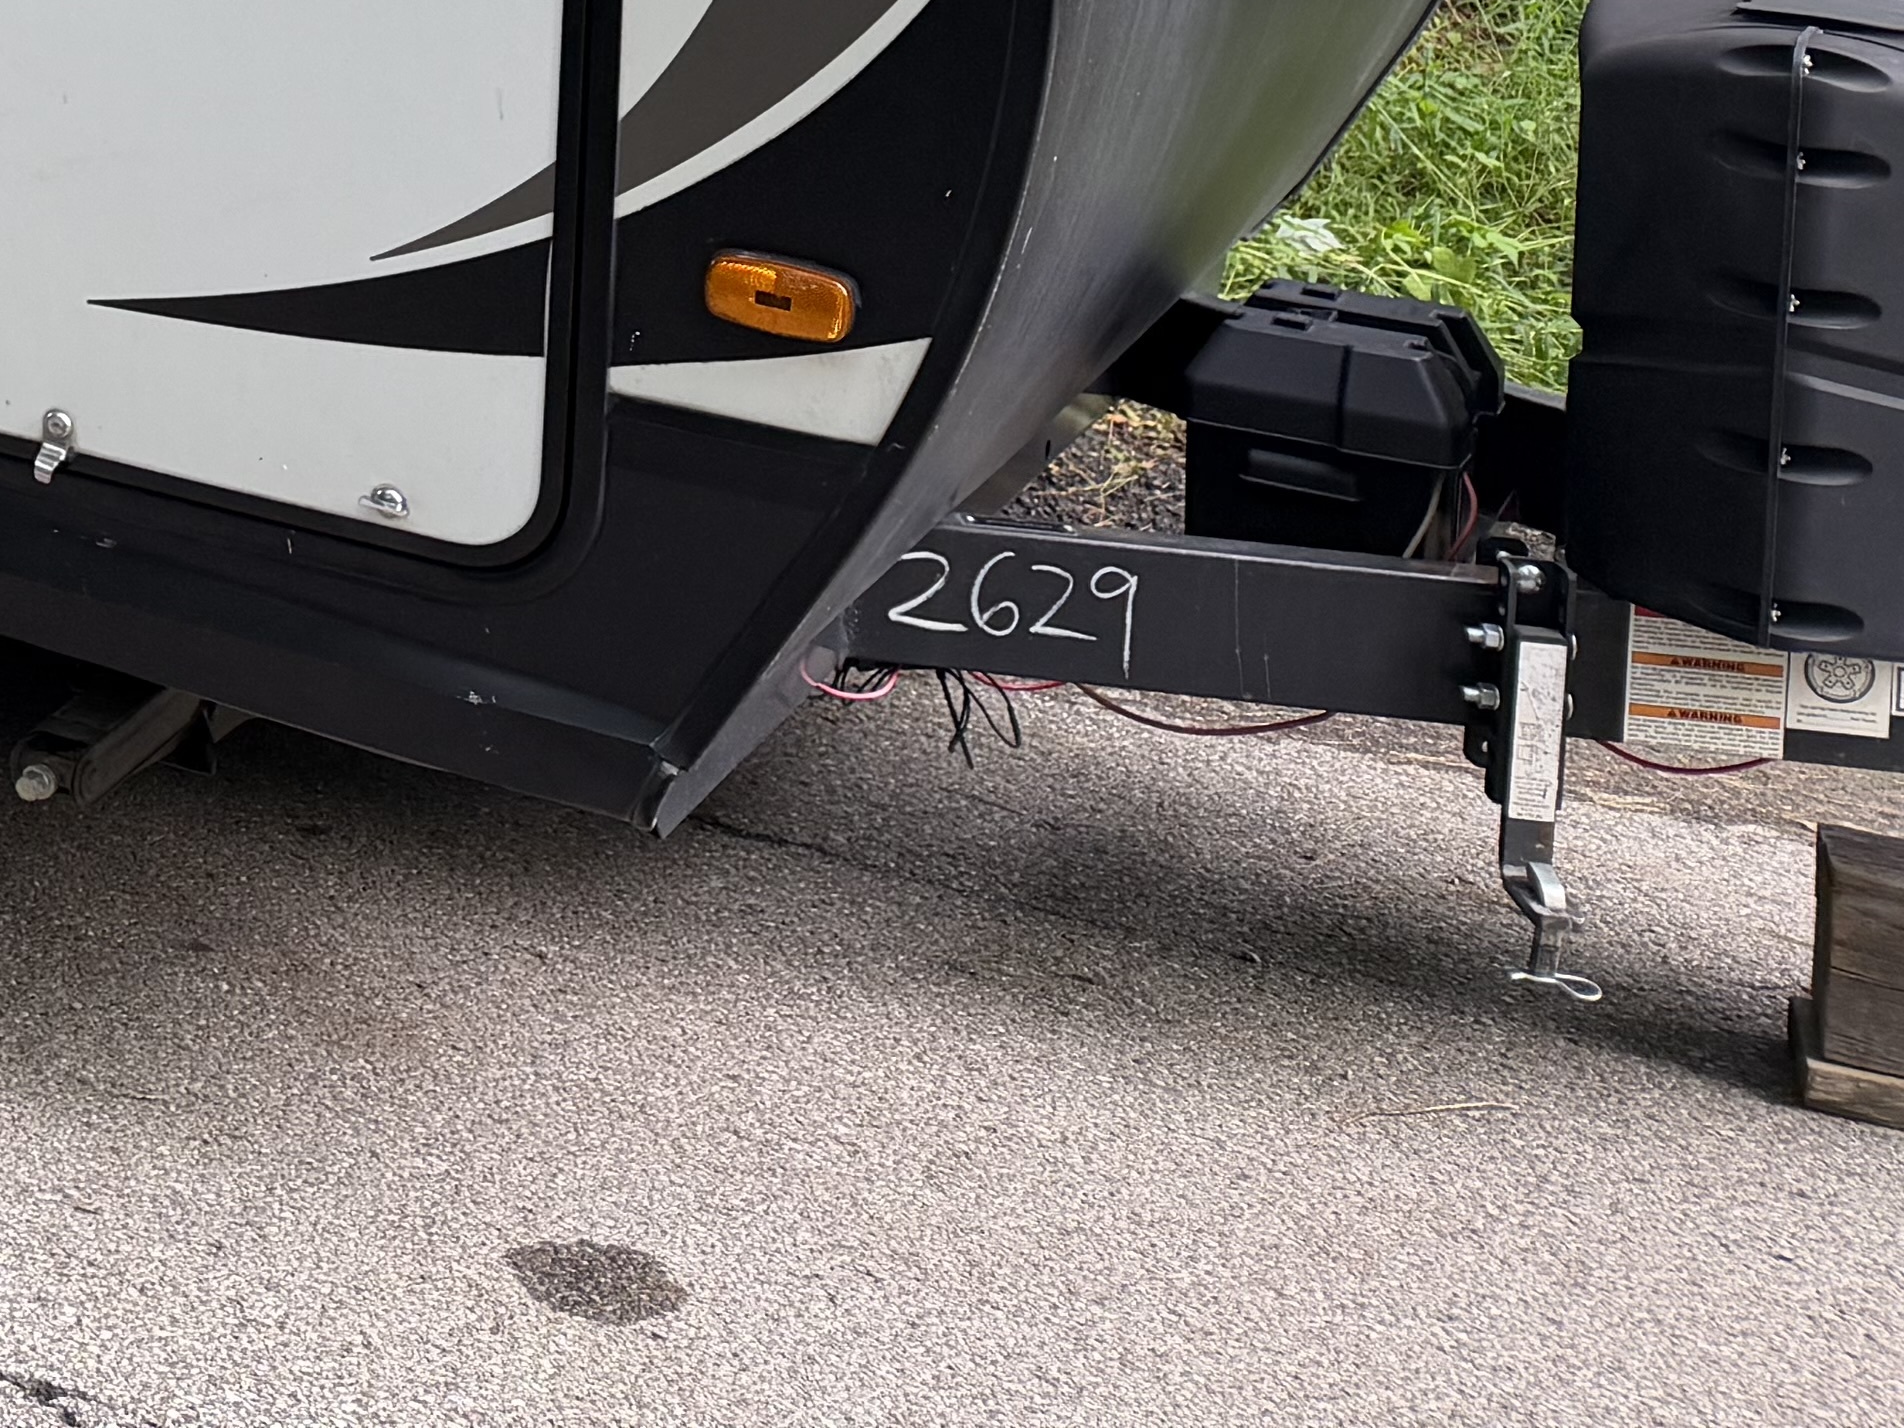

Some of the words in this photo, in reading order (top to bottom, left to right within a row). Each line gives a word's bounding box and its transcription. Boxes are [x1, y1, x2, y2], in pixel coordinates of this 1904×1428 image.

[886, 550, 1139, 678] 2629
[1682, 656, 1745, 672] WARNING
[1679, 709, 1743, 724] WARNING
